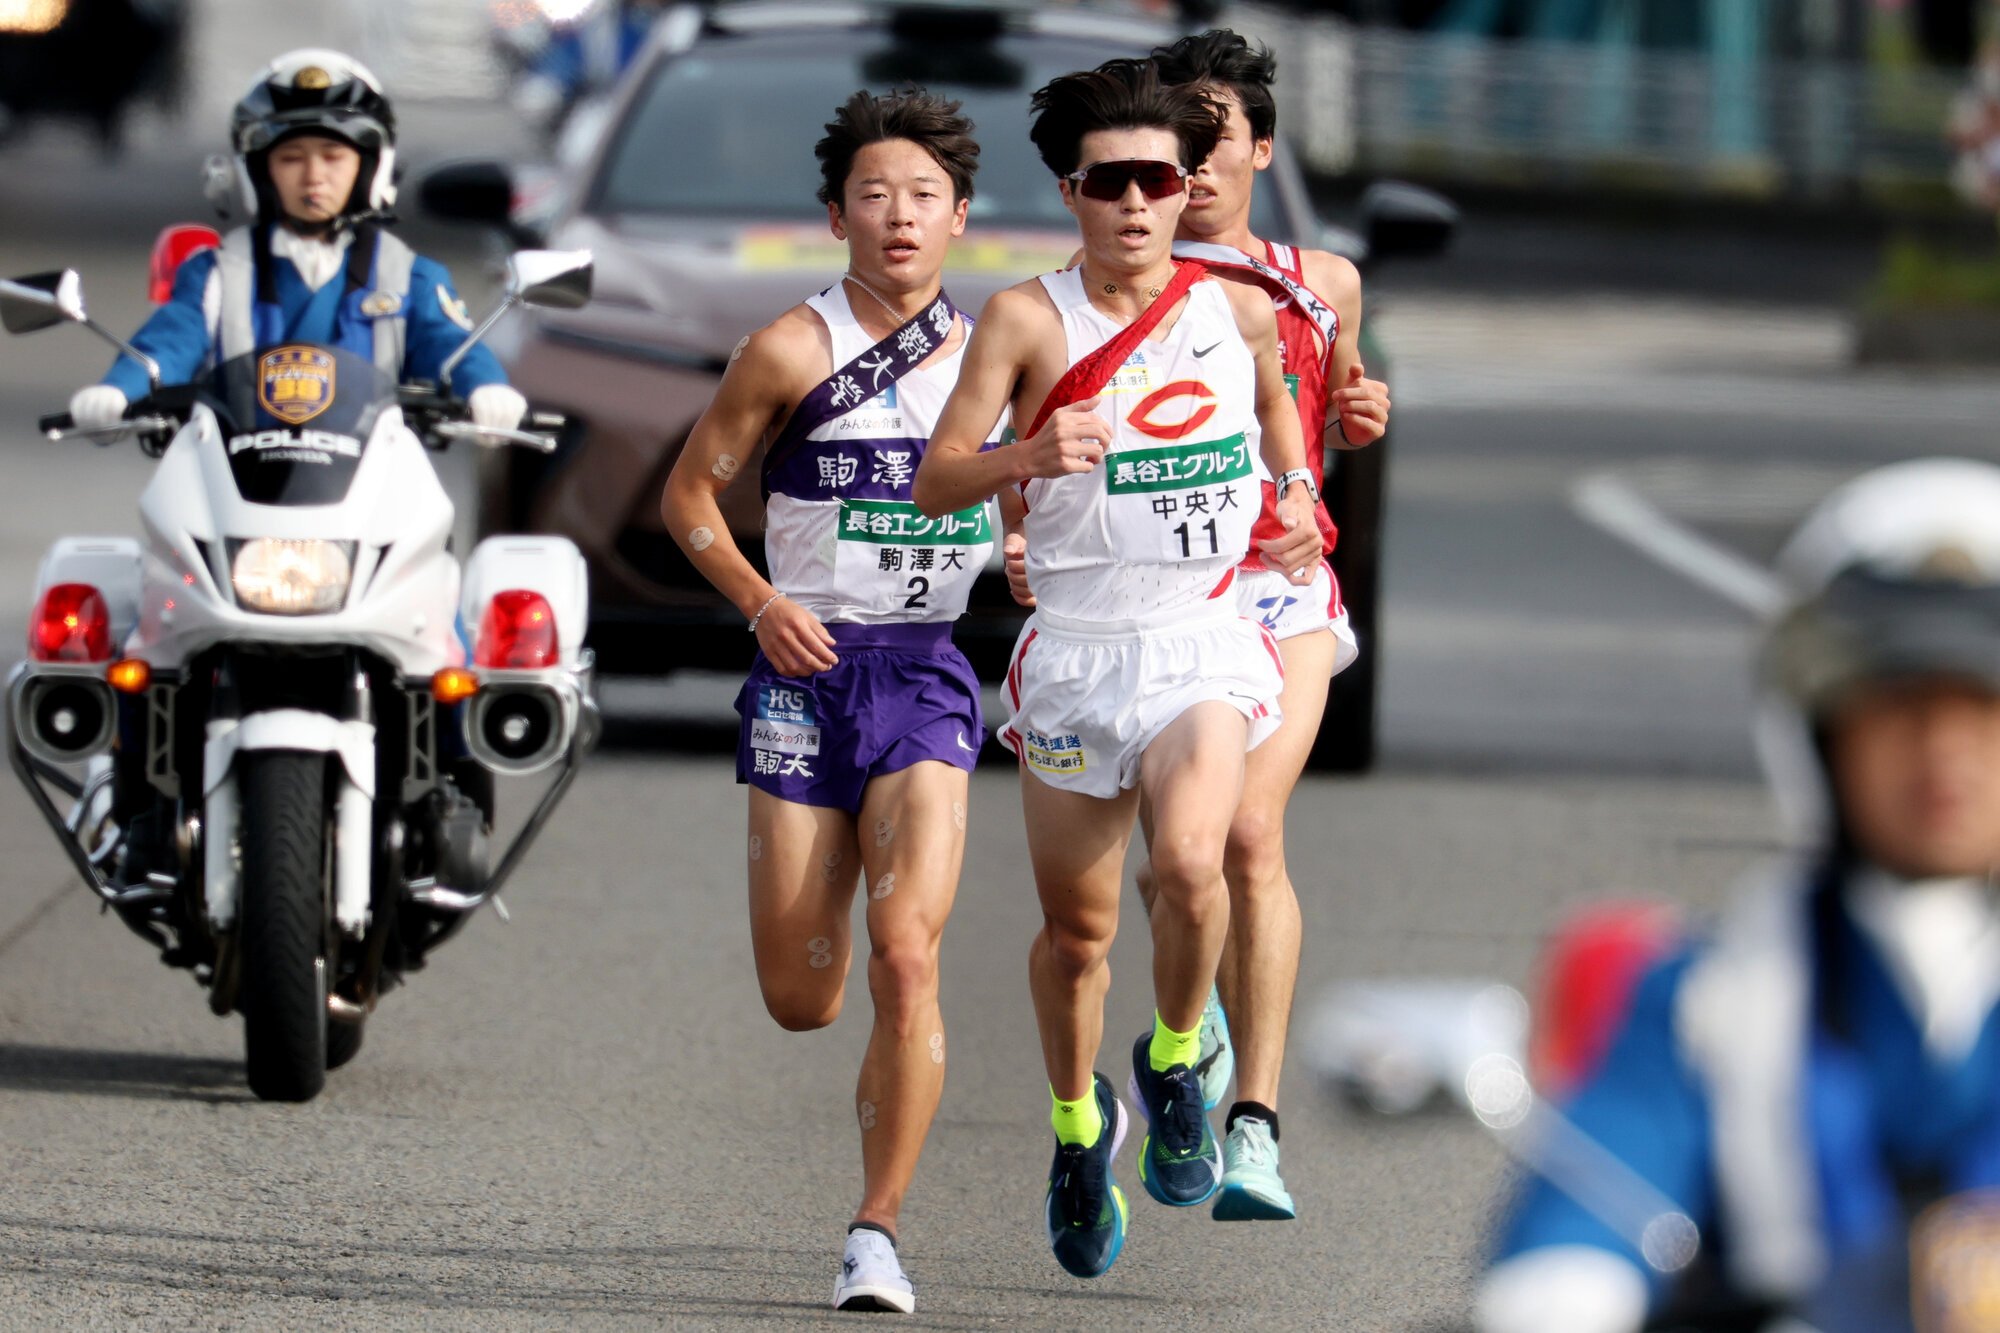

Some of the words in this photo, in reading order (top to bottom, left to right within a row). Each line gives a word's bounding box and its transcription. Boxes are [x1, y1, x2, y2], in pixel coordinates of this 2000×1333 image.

[839, 417, 903, 430] みんなの介護
[229, 429, 361, 458] POLICE
[260, 451, 333, 465] HONDA
[817, 450, 912, 490] 駒澤
[1152, 485, 1239, 520] 中央大
[1173, 518, 1219, 557] 11
[878, 547, 965, 571] 駒澤大
[904, 576, 929, 609] 2
[768, 689, 804, 711] HRS
[767, 710, 804, 721] ヒロセ電機
[752, 728, 819, 747] みんなの介護
[1027, 731, 1082, 751] 大矢運送
[754, 749, 814, 777] 駒大
